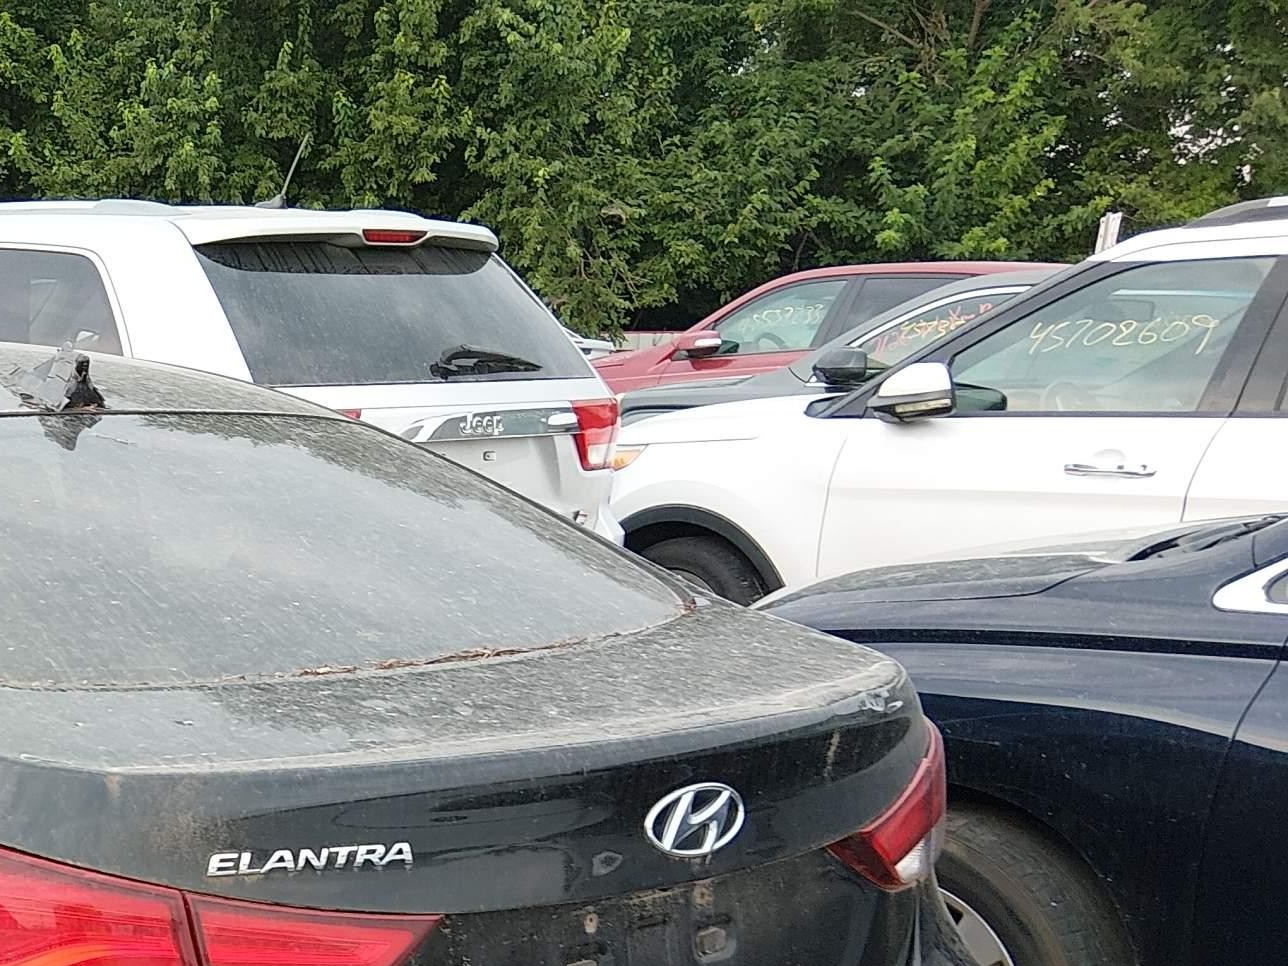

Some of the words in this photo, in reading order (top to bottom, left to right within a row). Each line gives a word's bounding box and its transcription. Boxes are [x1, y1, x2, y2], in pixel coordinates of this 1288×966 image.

[1029, 314, 1220, 354] 45702609
[459, 412, 504, 436] Jeep
[206, 842, 413, 876] ELANTRA
